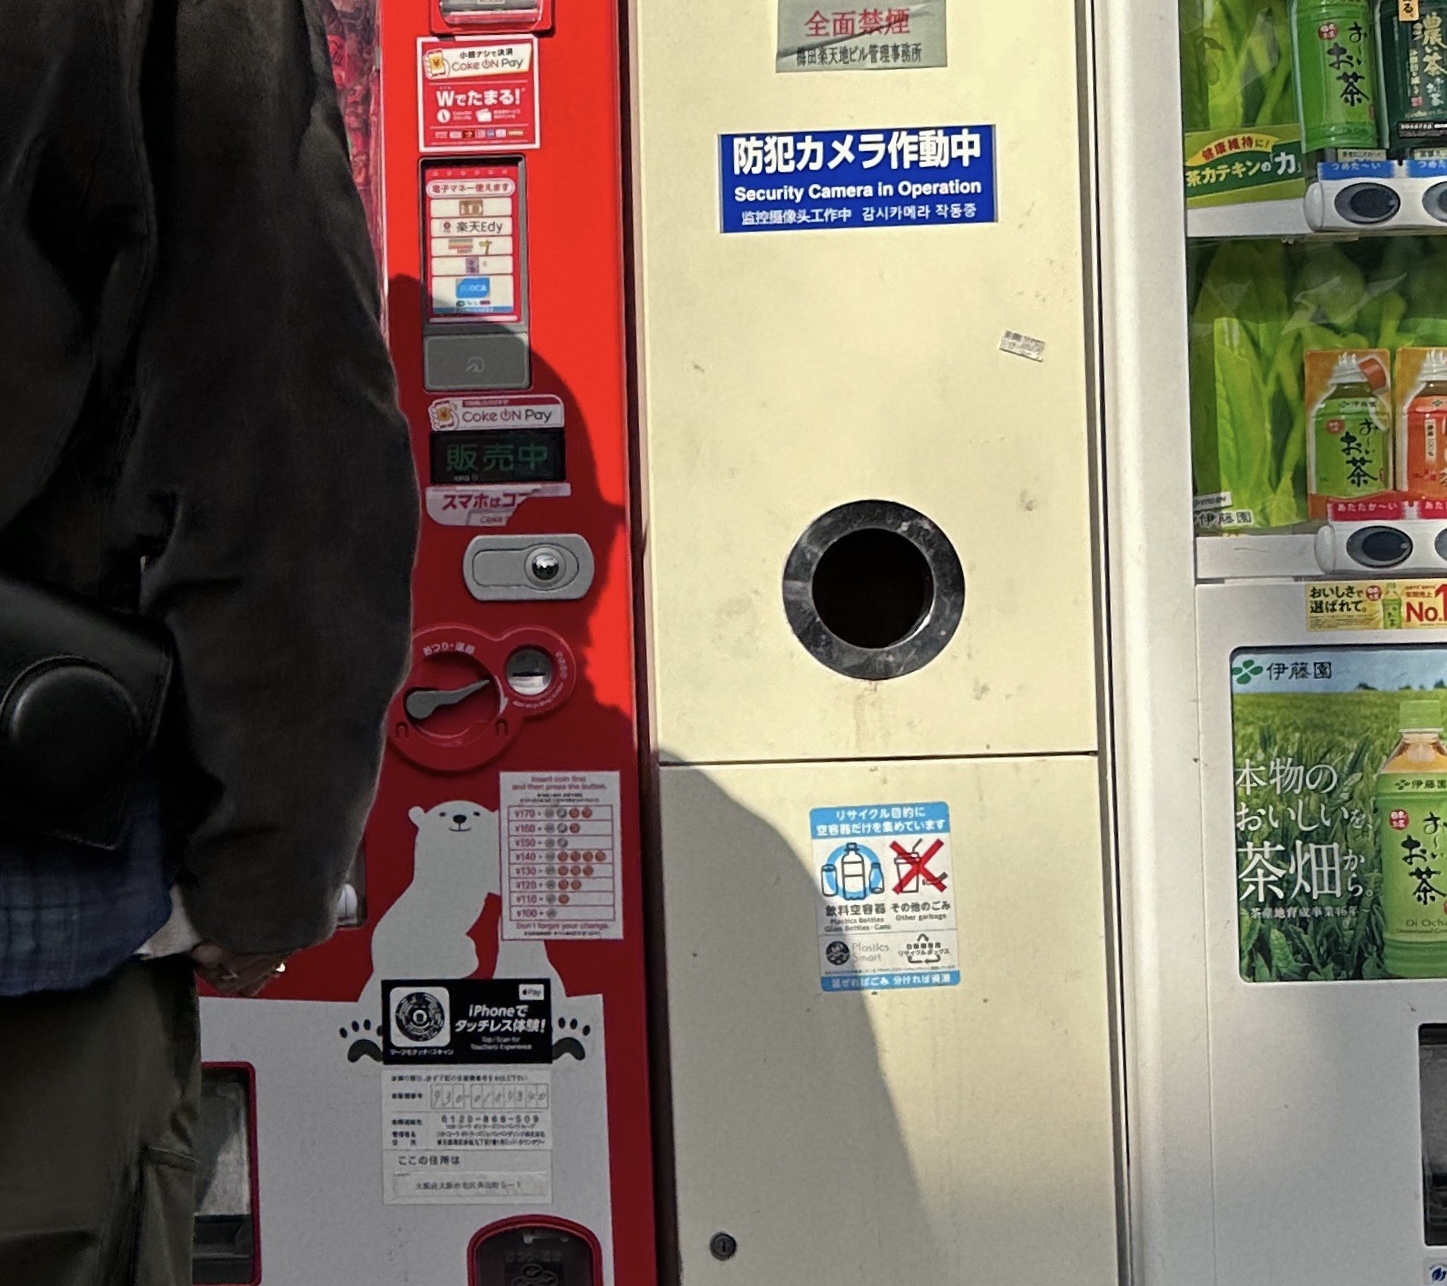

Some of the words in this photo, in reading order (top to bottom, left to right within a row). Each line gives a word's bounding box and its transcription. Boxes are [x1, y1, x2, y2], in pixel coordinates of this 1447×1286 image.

[805, 8, 911, 38] 全面禁煙
[796, 43, 922, 66] 梅田楽天地ビル管理事務所
[452, 61, 480, 72] Coke
[501, 58, 523, 70] Pay
[1327, 43, 1369, 106] お茶
[732, 128, 981, 175] 防犯カメラ作動中
[432, 184, 509, 194] 電子マネー使えます
[734, 185, 804, 203] Security
[808, 182, 874, 200] Camera
[877, 181, 894, 197] in
[898, 179, 982, 200] Operation
[861, 205, 930, 222] 감시카메라
[456, 220, 503, 234] 楽天Edy
[462, 411, 498, 422] Coke
[525, 409, 552, 423] Pay
[446, 443, 549, 472] 販売中
[1340, 432, 1378, 488] お茶
[1337, 503, 1398, 512] あたたか〜い
[1310, 585, 1364, 599] おいしさで
[1310, 600, 1367, 613] 選ばれて。
[1266, 661, 1332, 681] 伊藤園
[1235, 758, 1337, 795] 本物の
[836, 806, 926, 820] リサイクル目的に
[816, 819, 945, 836] 空容器だけを集めています
[1401, 834, 1446, 906] お茶
[825, 903, 886, 918] 飲料空容器
[891, 901, 951, 913] その他のごみ
[918, 913, 947, 922] garbage
[469, 1004, 529, 1018] iPhoneで
[455, 1019, 545, 1034] タッチレス体験!
[399, 1155, 460, 1165] ここの住所は
